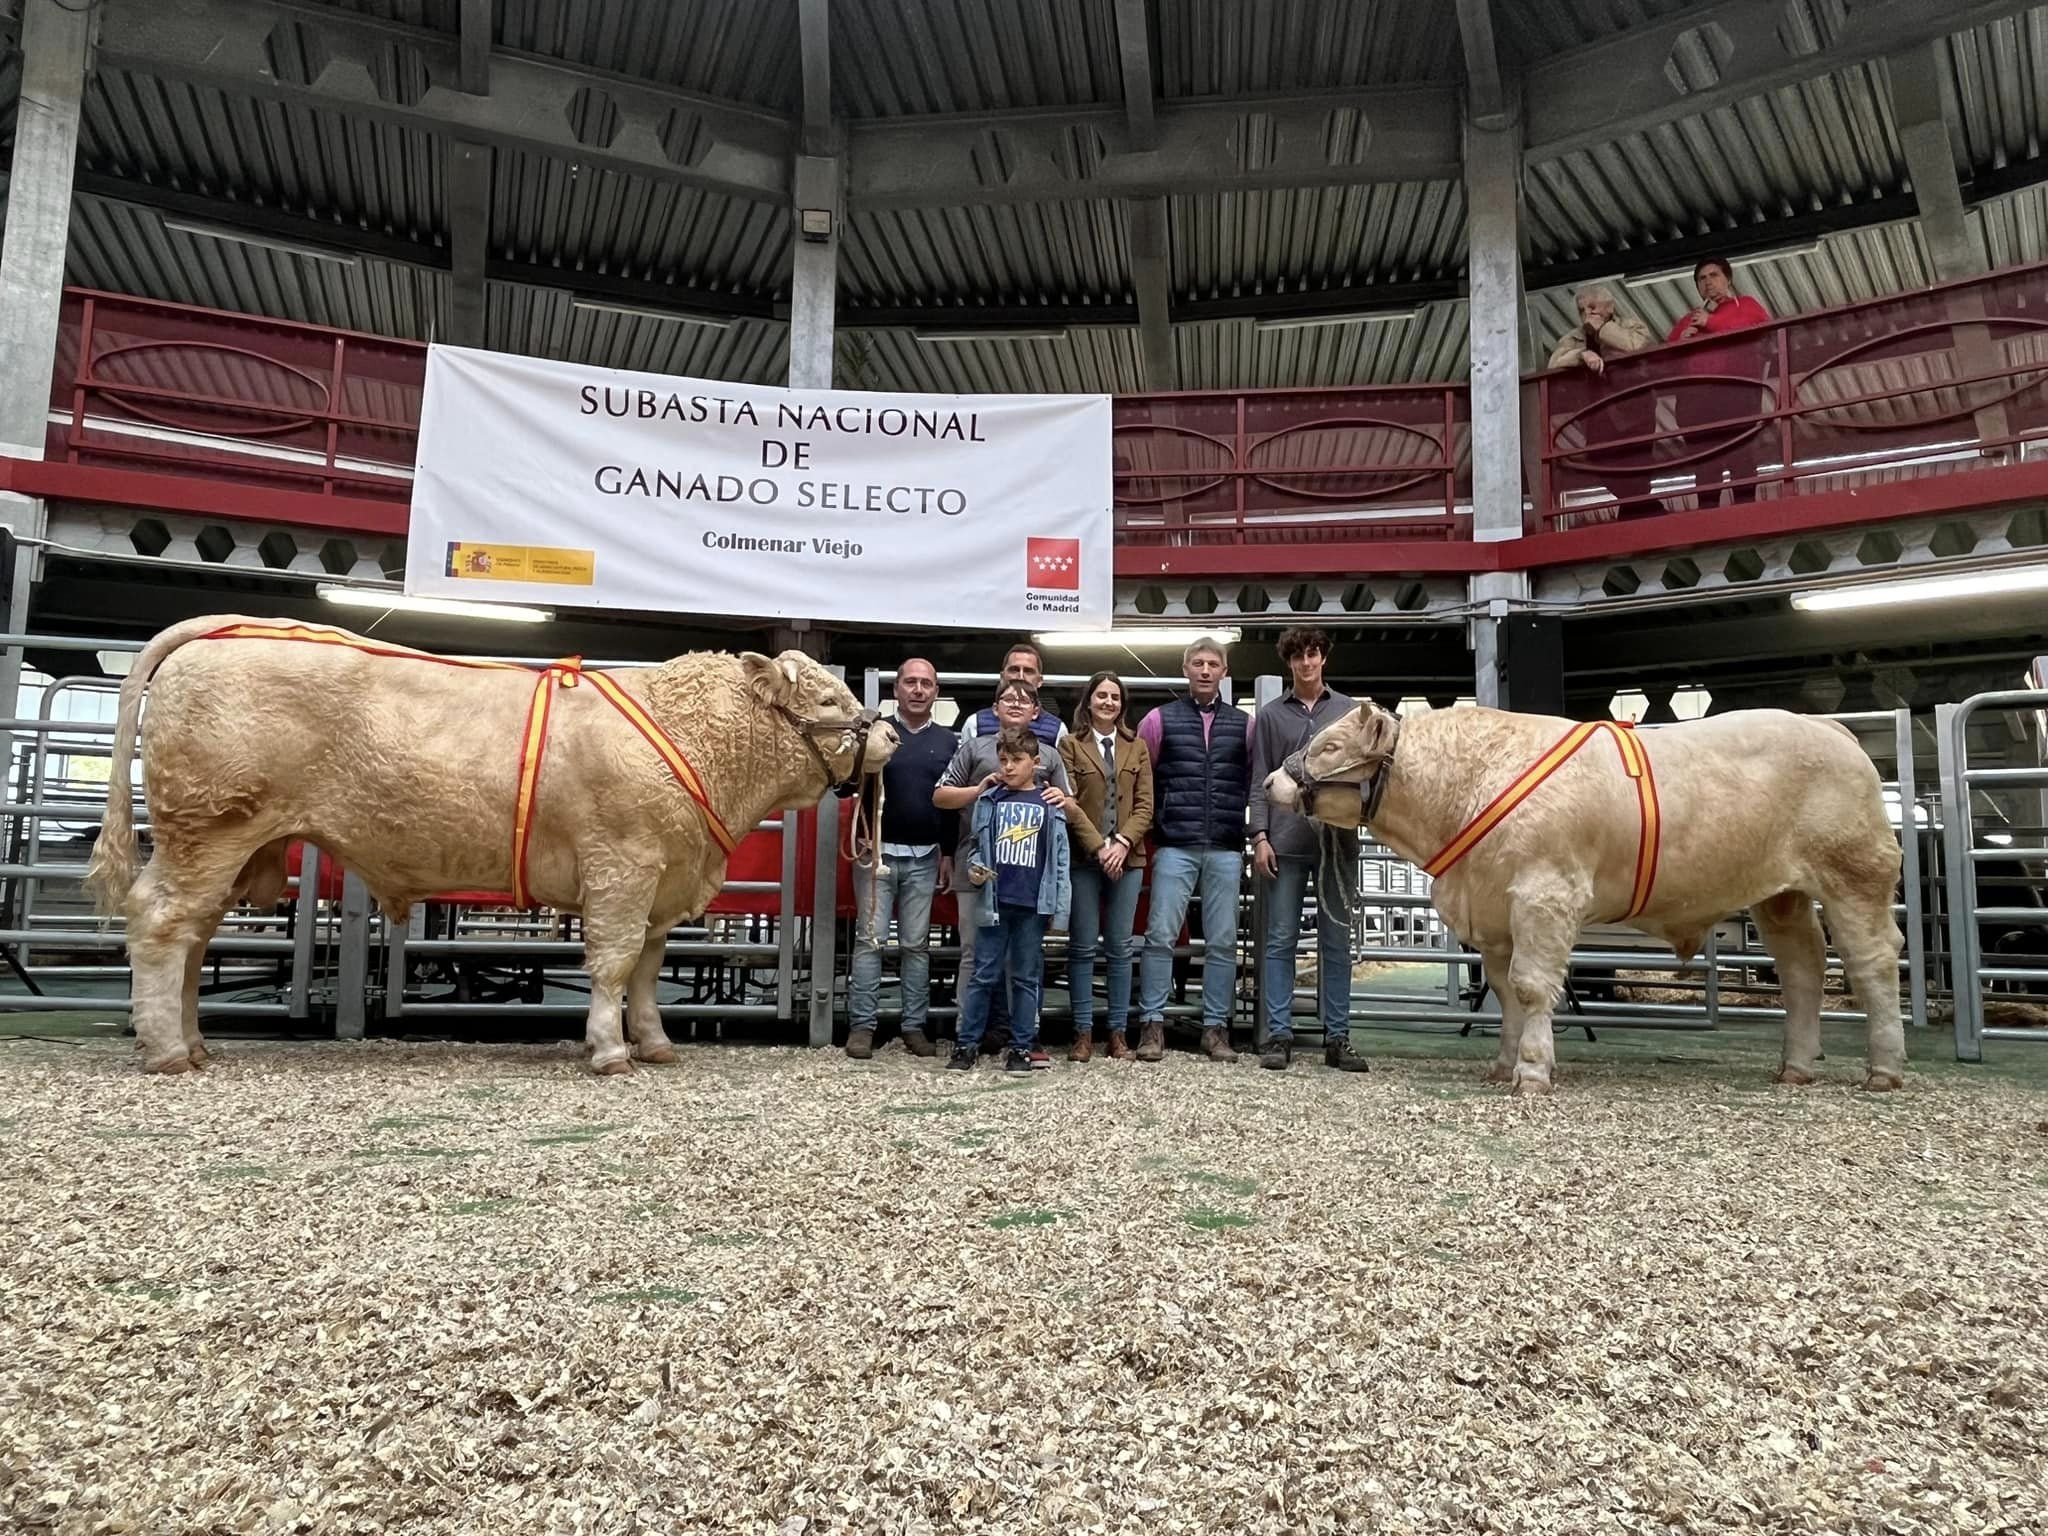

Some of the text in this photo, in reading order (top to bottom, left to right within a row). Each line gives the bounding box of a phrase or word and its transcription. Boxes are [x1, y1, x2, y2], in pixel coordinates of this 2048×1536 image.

[580, 385, 986, 442] SUBASTA NACIONAL
[762, 440, 811, 470] DE
[594, 465, 967, 516] GANADO SELECTO
[702, 531, 863, 559] Colmenar Viejo
[1026, 592, 1080, 603] Comunidad
[1026, 602, 1080, 613] de Madrid
